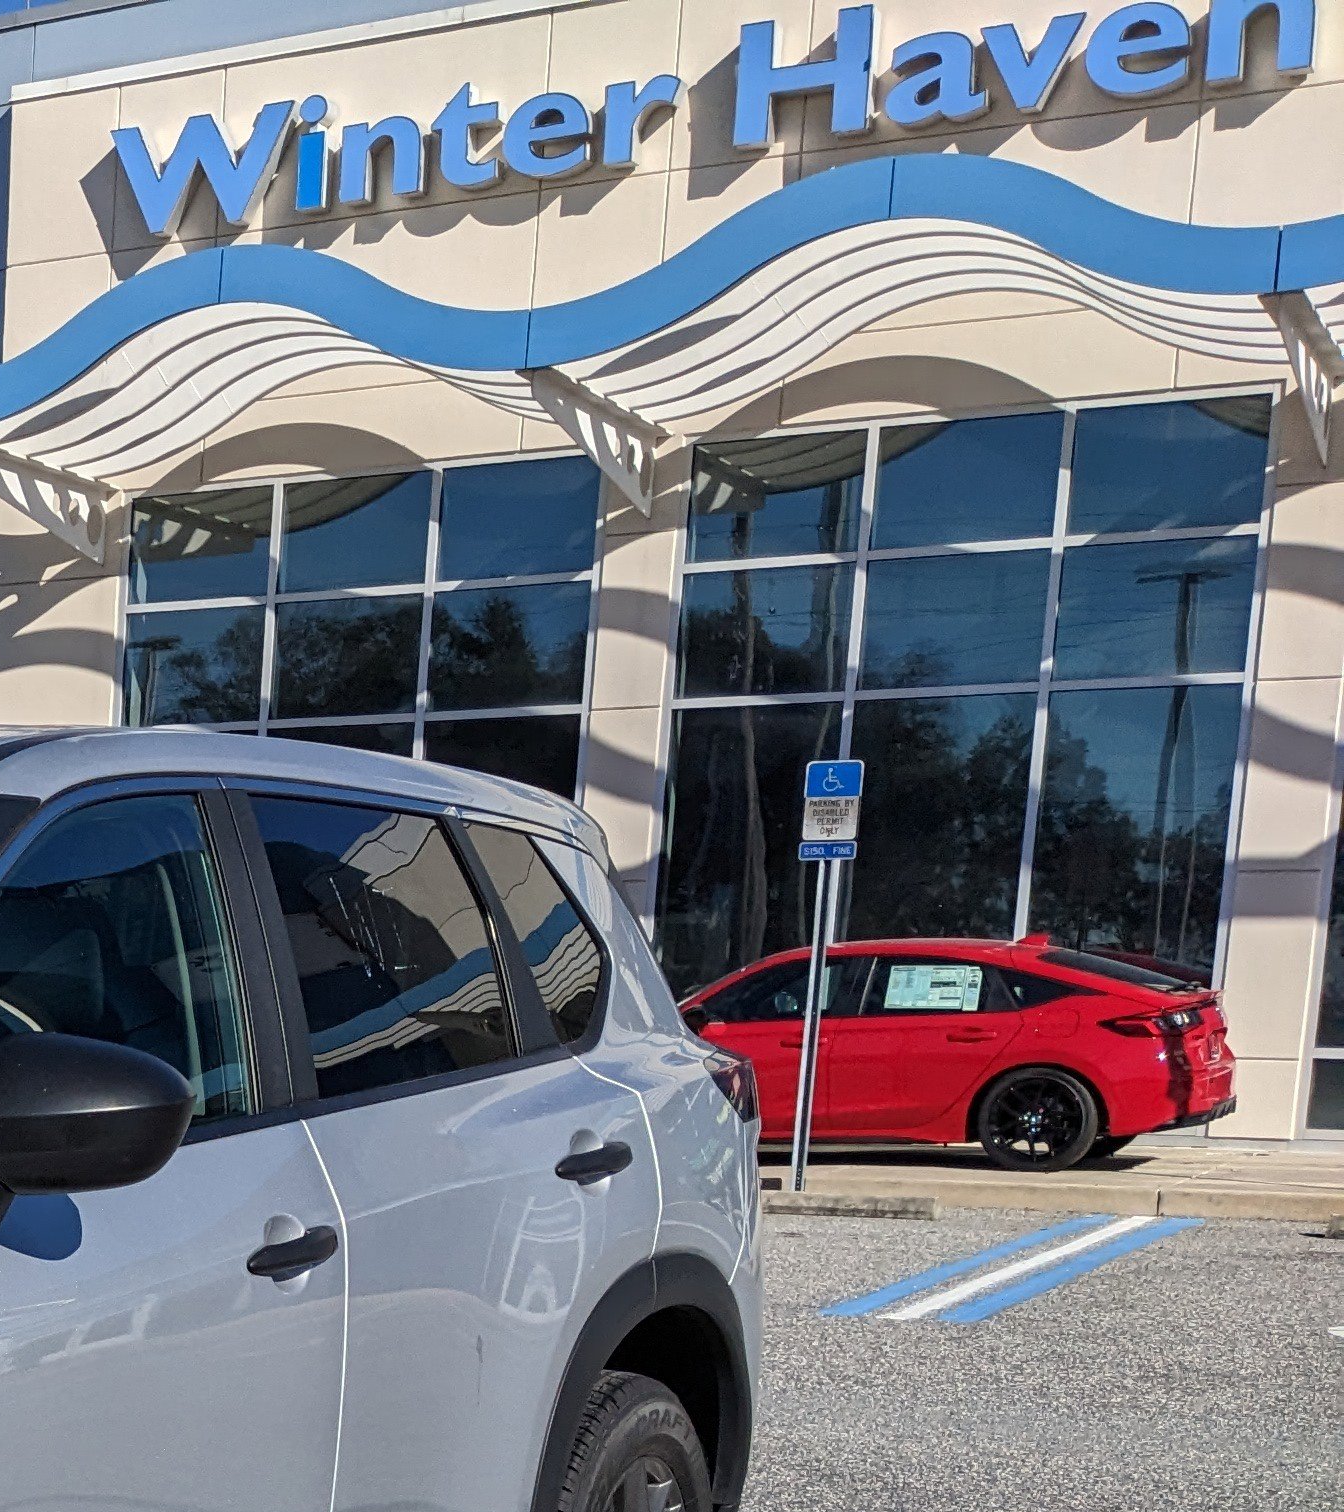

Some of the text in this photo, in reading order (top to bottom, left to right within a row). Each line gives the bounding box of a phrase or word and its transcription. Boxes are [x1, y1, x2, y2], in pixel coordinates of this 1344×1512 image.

[111, 0, 1316, 235] Winter Haven
[808, 799, 855, 807] PARKING BY
[812, 808, 850, 817] DISABLED
[816, 817, 844, 826] PERMIT
[819, 826, 840, 835] ONLY
[832, 846, 852, 855] FINE
